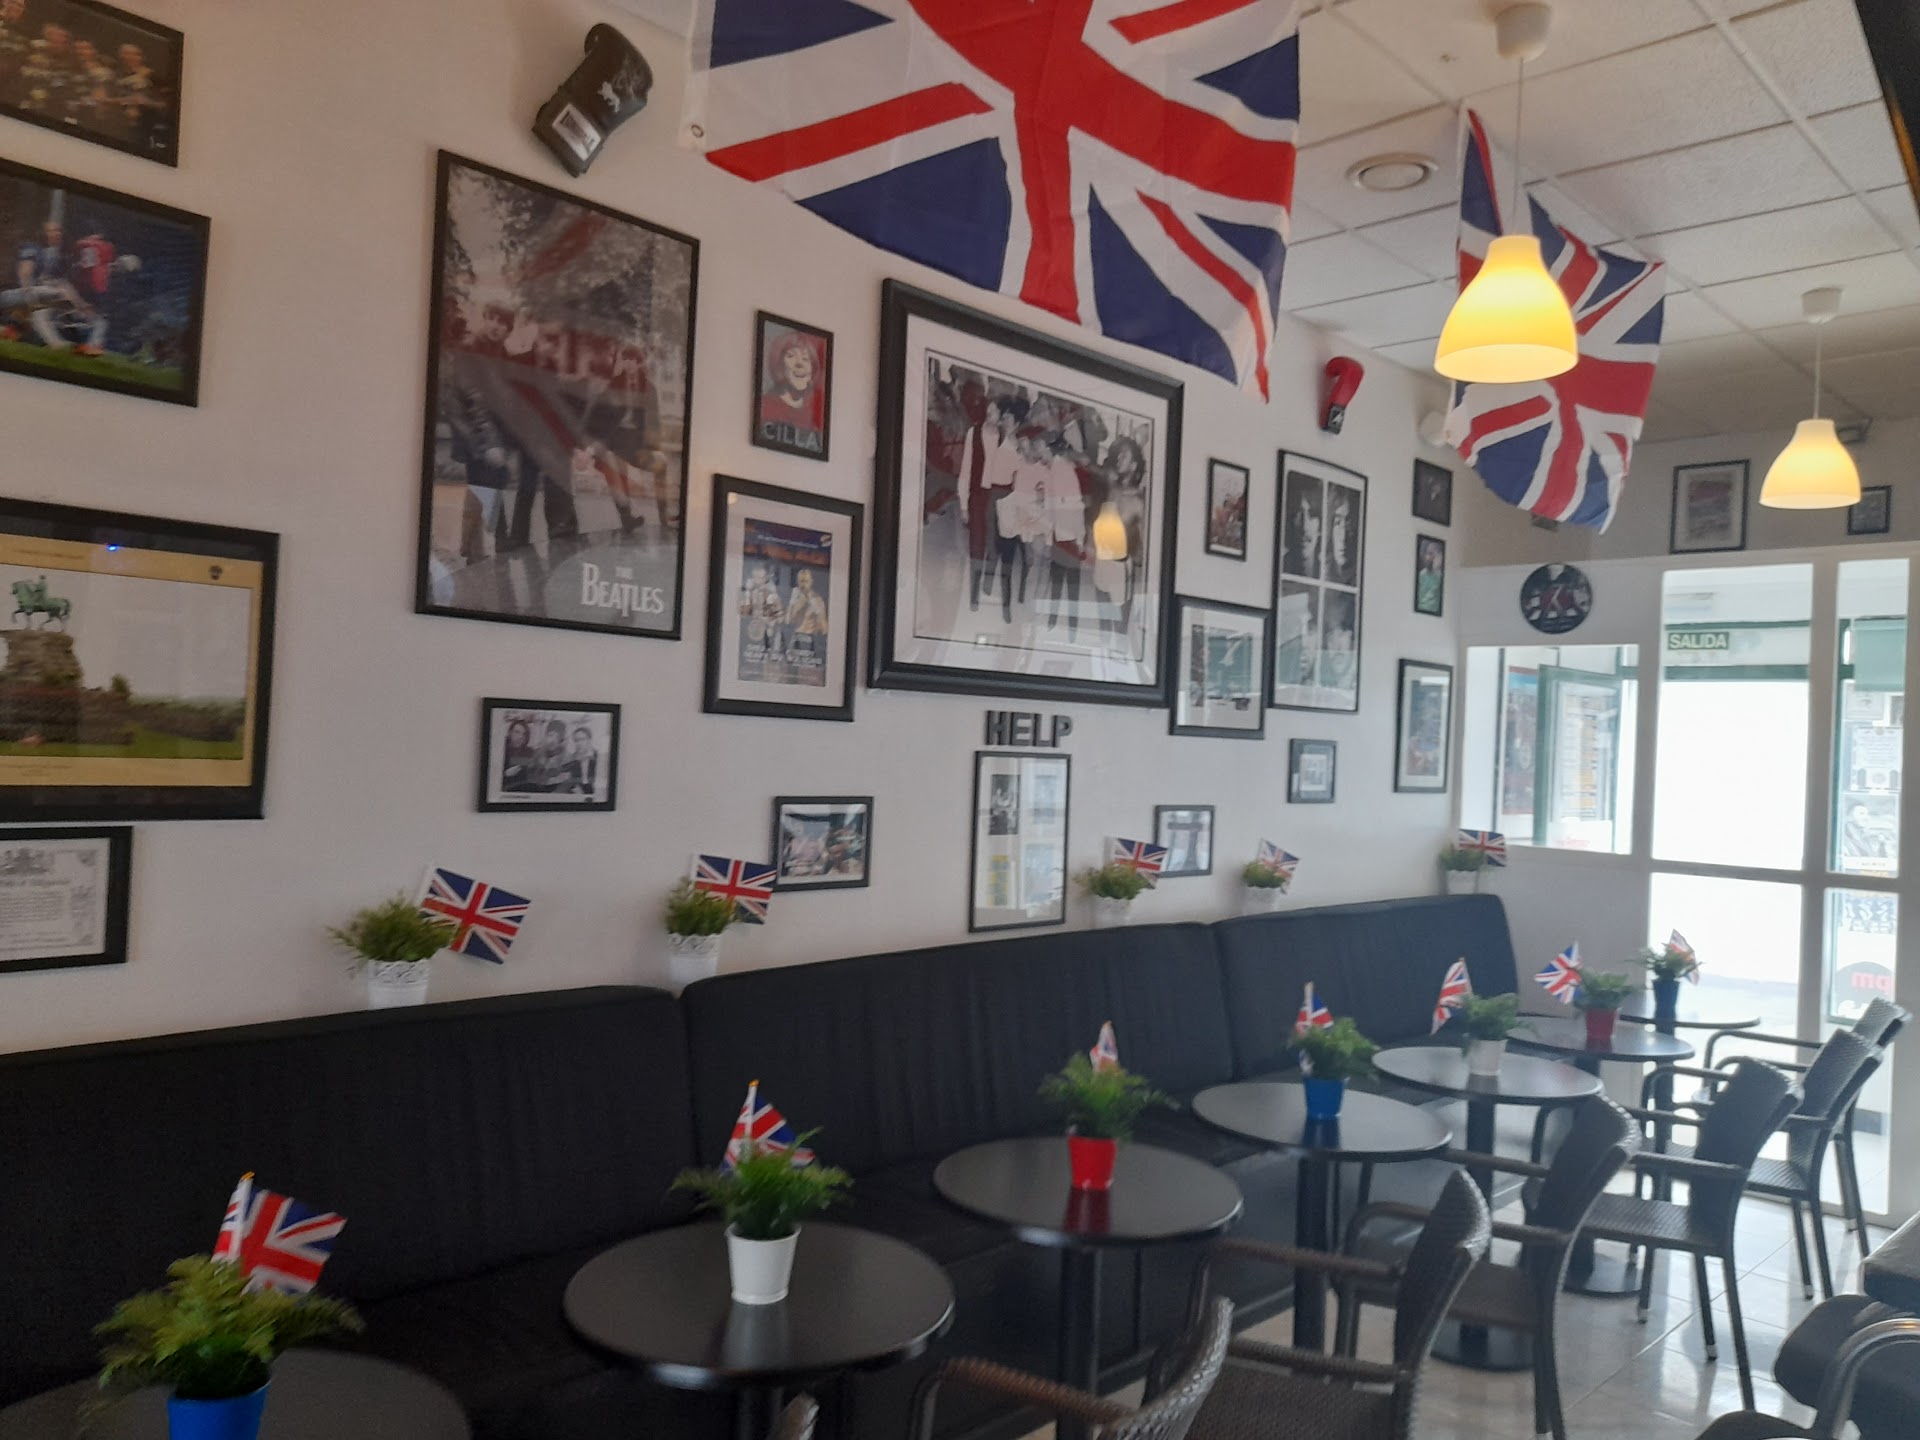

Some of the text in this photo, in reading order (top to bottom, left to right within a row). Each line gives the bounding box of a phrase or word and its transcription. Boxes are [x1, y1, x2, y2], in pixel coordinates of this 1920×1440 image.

[762, 421, 817, 449] CILLA
[1669, 633, 1727, 649] SALIDA
[984, 710, 1072, 748] HELP
